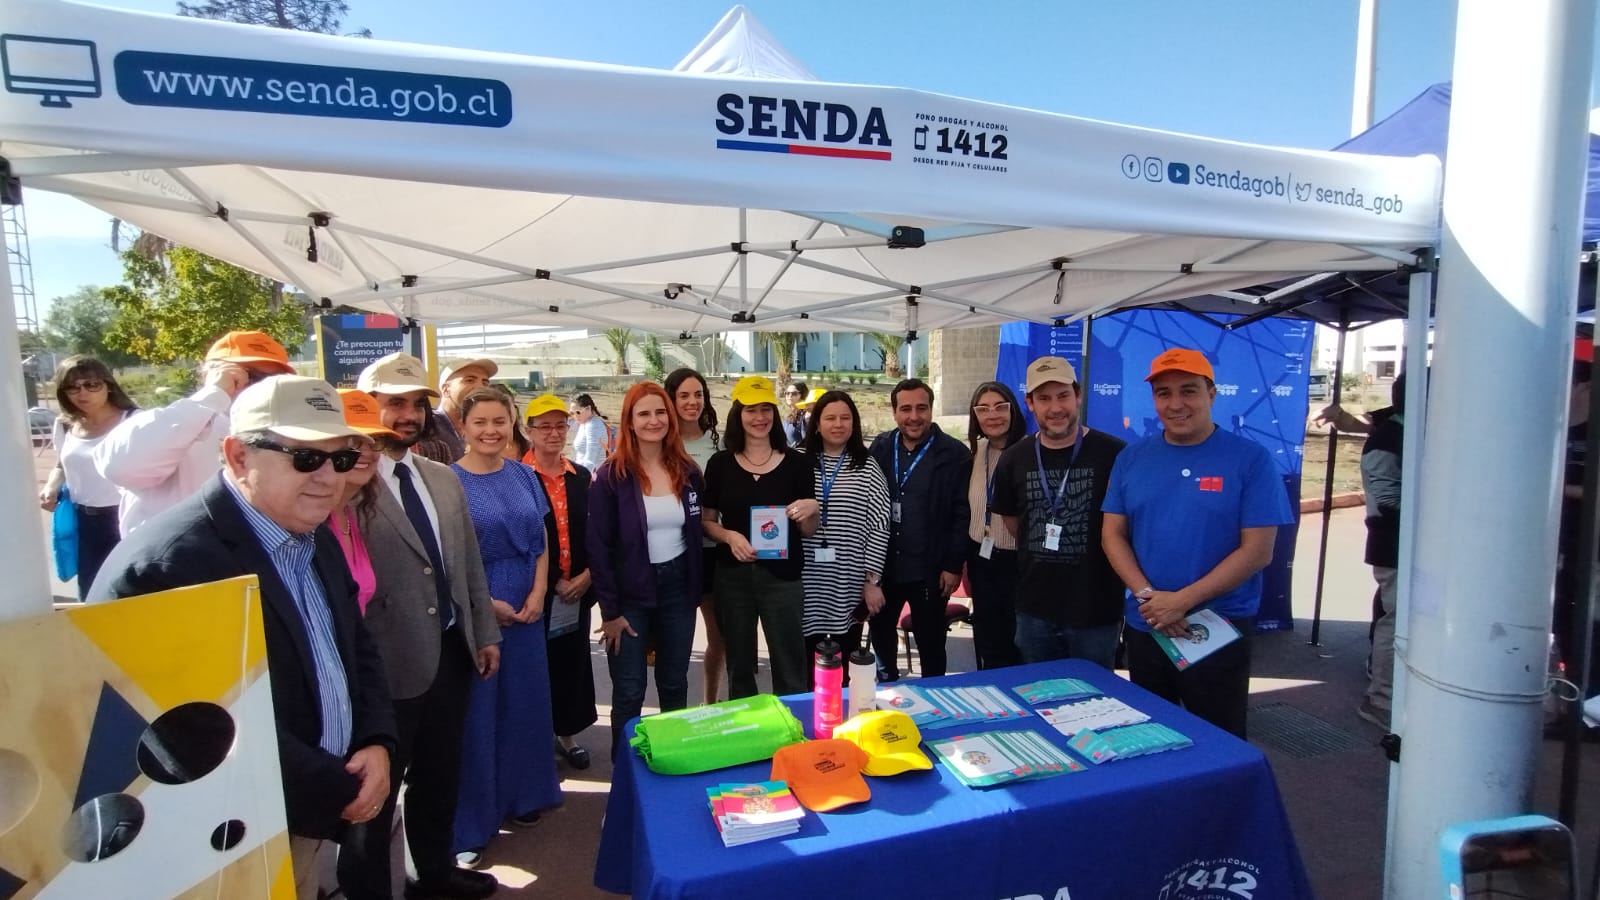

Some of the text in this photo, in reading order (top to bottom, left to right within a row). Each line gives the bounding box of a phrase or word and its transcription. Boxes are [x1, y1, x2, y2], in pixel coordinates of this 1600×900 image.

[143, 69, 498, 117] www.senda.gob.cl
[715, 93, 892, 147] SENDA
[915, 113, 936, 122] FONO
[938, 116, 968, 126] DROGAS
[976, 121, 1008, 132] ALCOHOL
[936, 127, 1008, 160] 1412
[913, 157, 934, 165] DESDE
[972, 163, 1008, 173] CELULARES
[1194, 164, 1285, 198] Sendagob
[1315, 187, 1403, 215] senda_gob
[335, 341, 348, 350] ¿Te
[350, 341, 393, 349] preocupan
[339, 357, 368, 365] alguien
